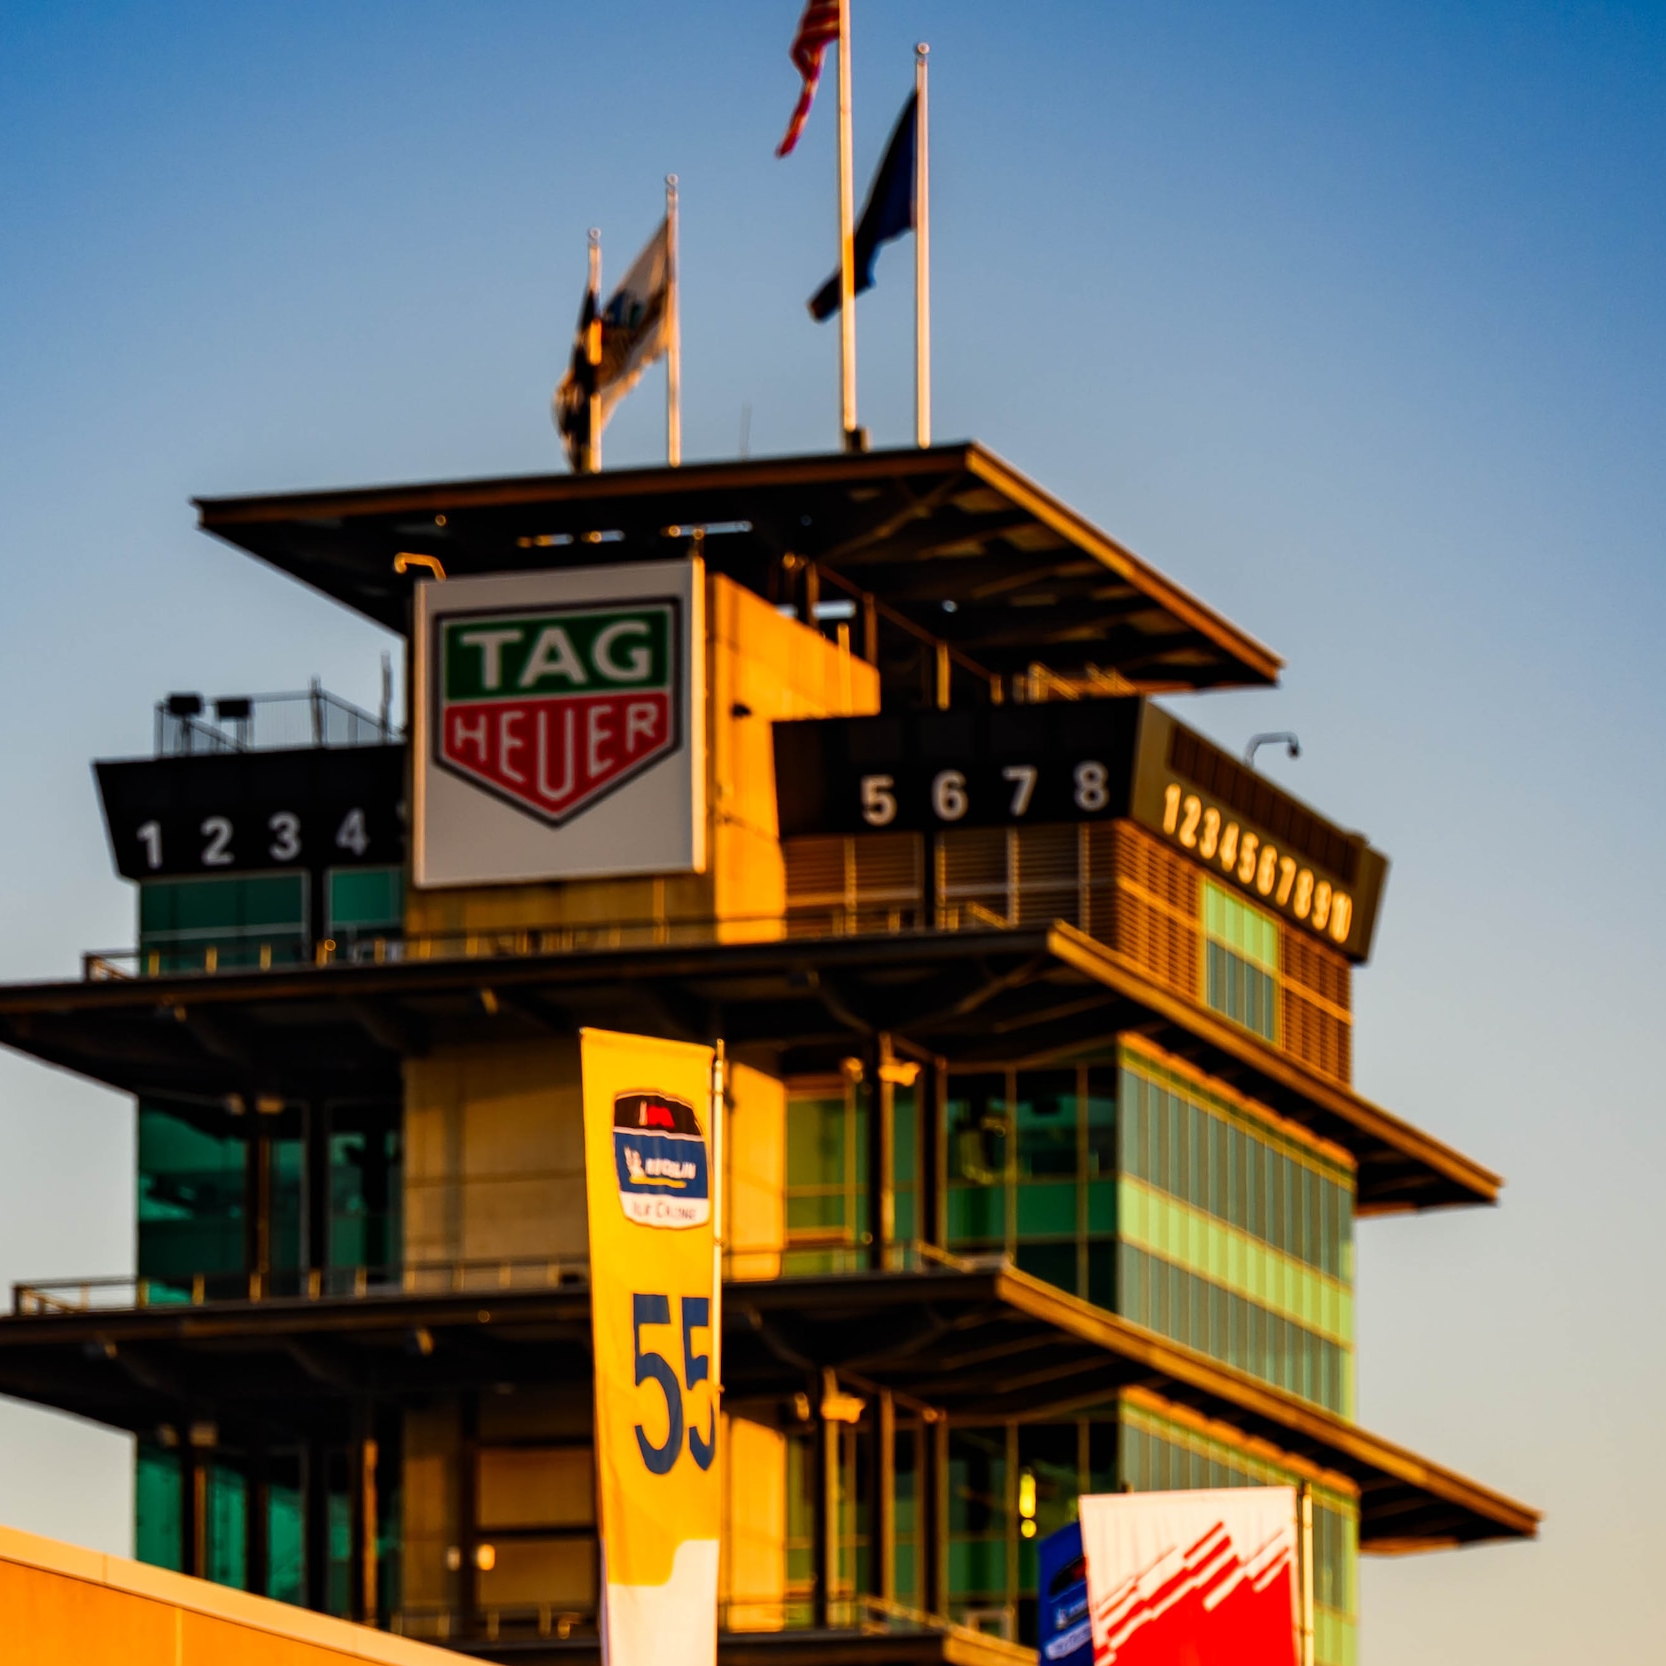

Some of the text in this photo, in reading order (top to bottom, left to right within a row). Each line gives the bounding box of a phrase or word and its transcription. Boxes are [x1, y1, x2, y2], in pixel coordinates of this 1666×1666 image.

[460, 620, 652, 690] TAG
[453, 702, 657, 800] HEUER
[860, 760, 1109, 826] 5 6 7 8
[136, 807, 370, 870] 1 2 3 4
[634, 1294, 715, 1475] 55
